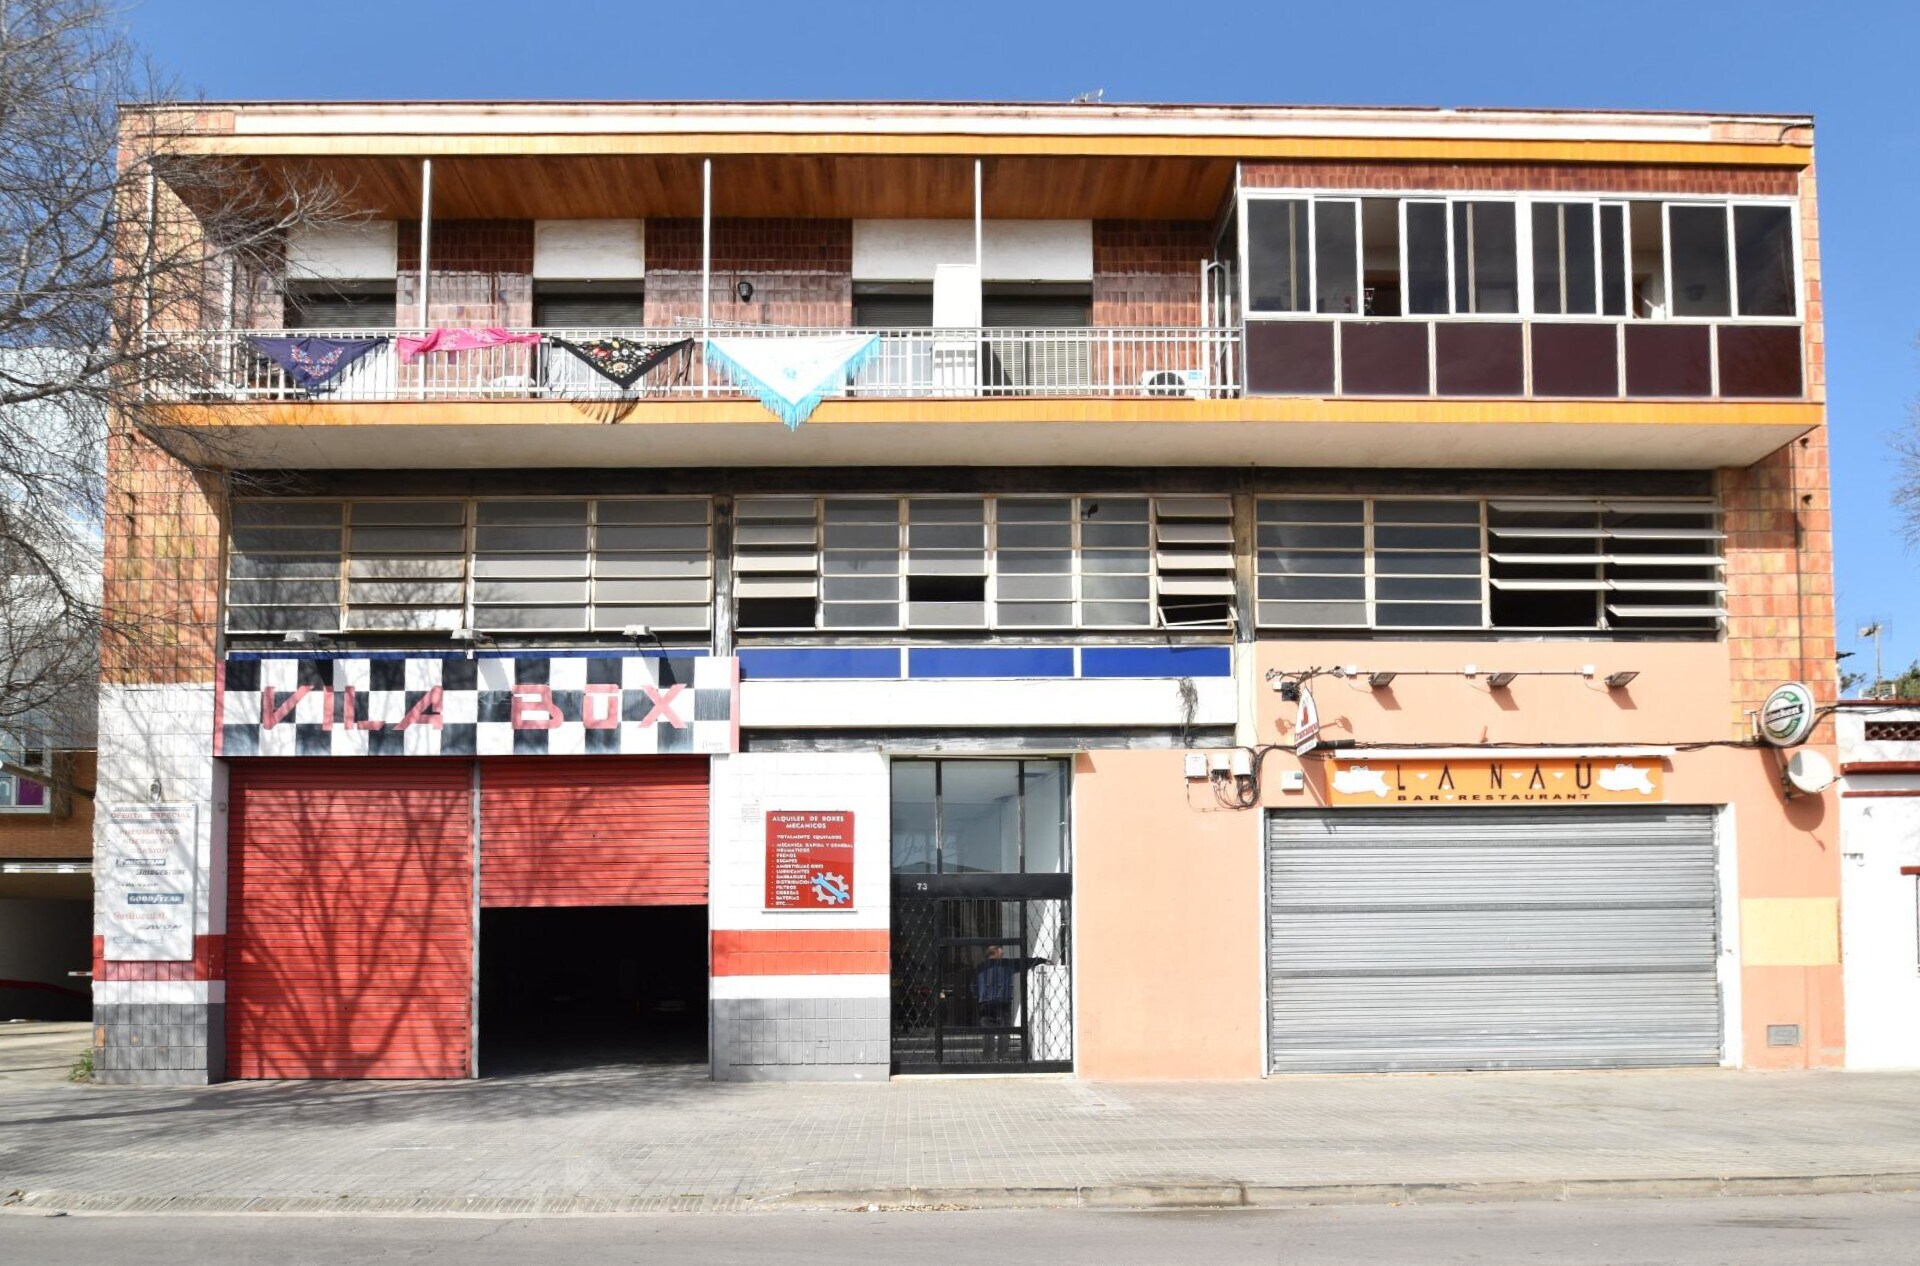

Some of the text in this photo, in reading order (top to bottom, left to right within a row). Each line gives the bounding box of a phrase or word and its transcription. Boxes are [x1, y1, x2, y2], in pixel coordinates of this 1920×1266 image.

[263, 683, 687, 731] VILA BOX
[1458, 793, 1592, 801] RESTAURANT
[916, 882, 928, 891] 73
[129, 894, 182, 903] GOODYEAR
